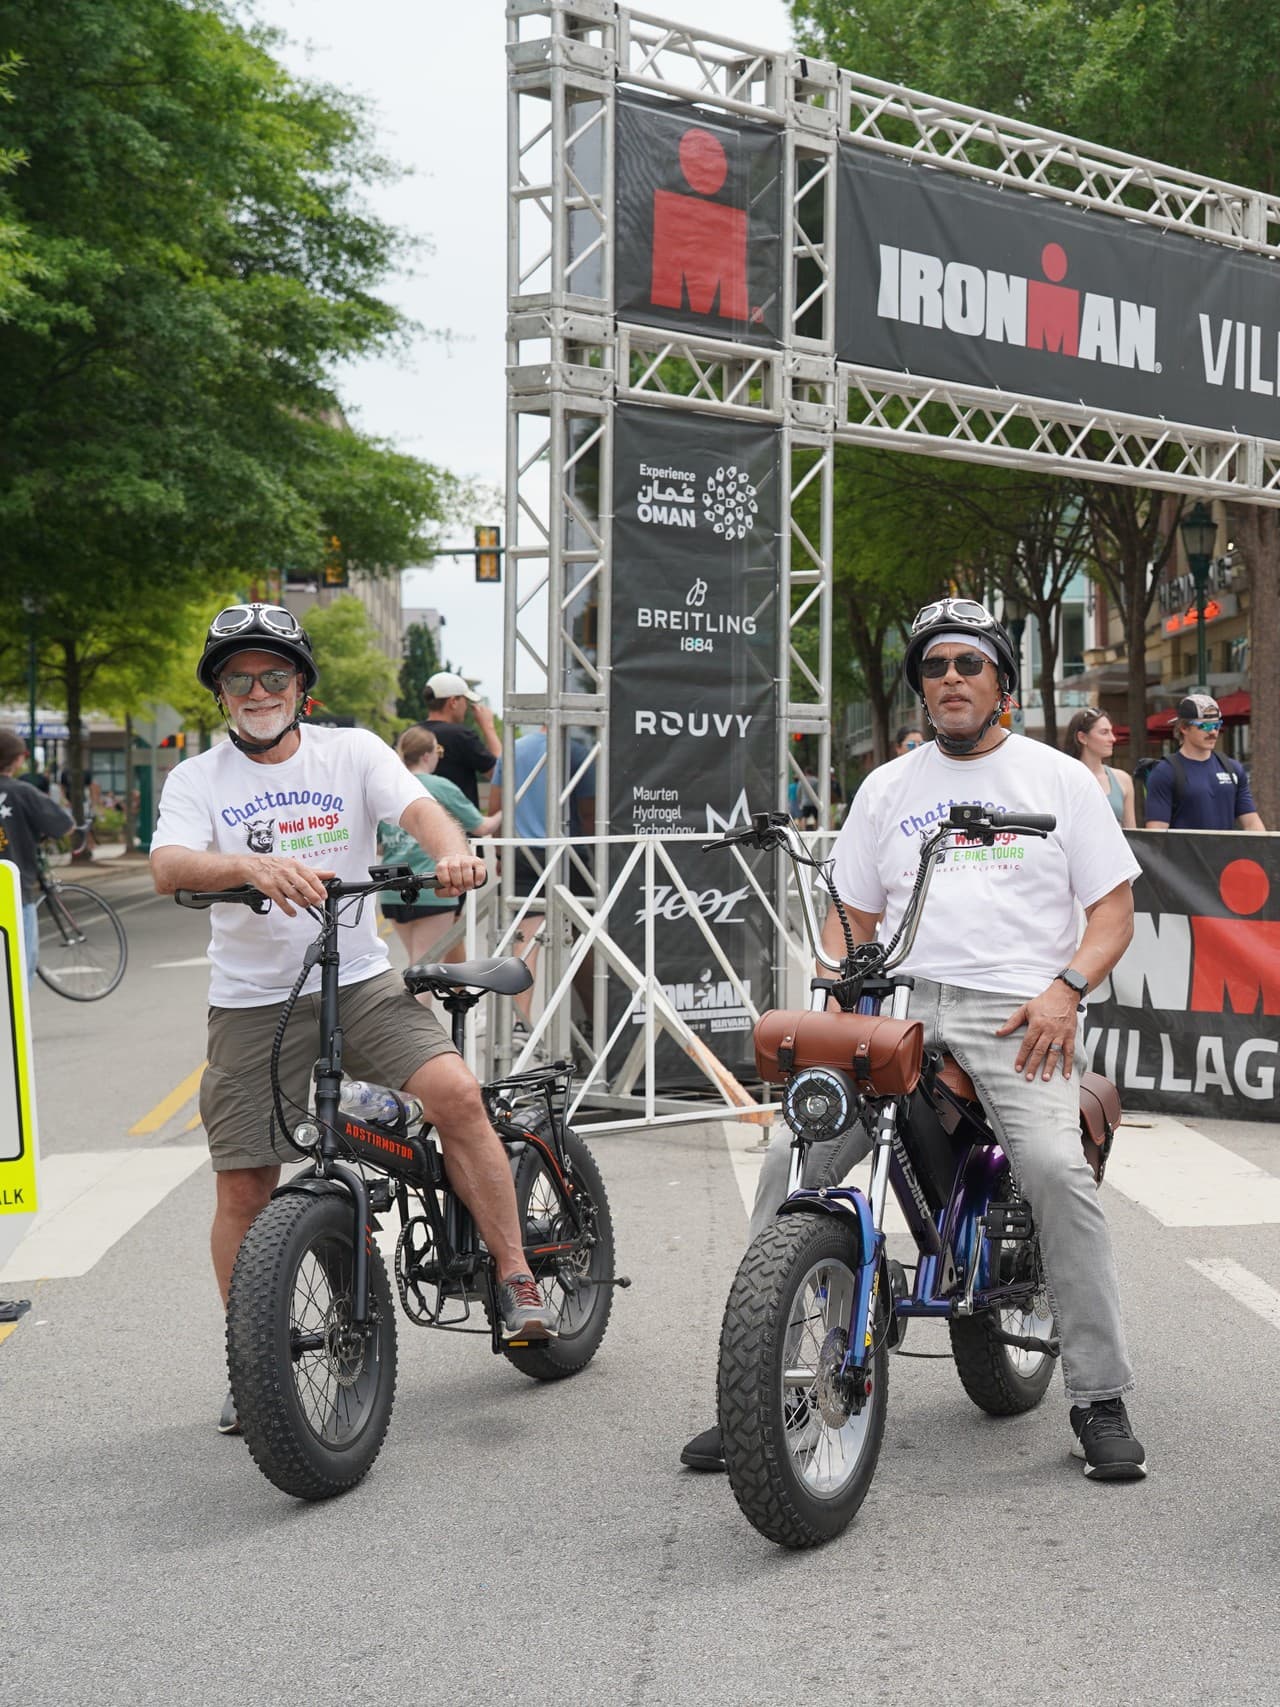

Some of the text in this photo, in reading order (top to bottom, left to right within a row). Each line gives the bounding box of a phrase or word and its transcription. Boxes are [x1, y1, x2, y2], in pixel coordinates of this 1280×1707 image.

[877, 243, 1157, 373] IRONMAN
[639, 463, 696, 482] Experience
[637, 503, 696, 528] OMAN
[637, 607, 757, 635] BREITLING
[680, 636, 713, 653] 1884
[635, 710, 752, 738] ROUVY
[633, 786, 679, 801] Maurten
[221, 790, 345, 827] Chattanooga
[633, 805, 682, 822] Hydrogel
[279, 812, 340, 834] Wild Hogs
[281, 828, 349, 852] E-BIKE TOURS
[302, 844, 349, 859] ELECTRIC
[953, 848, 1024, 862] E-BIKE TOURS
